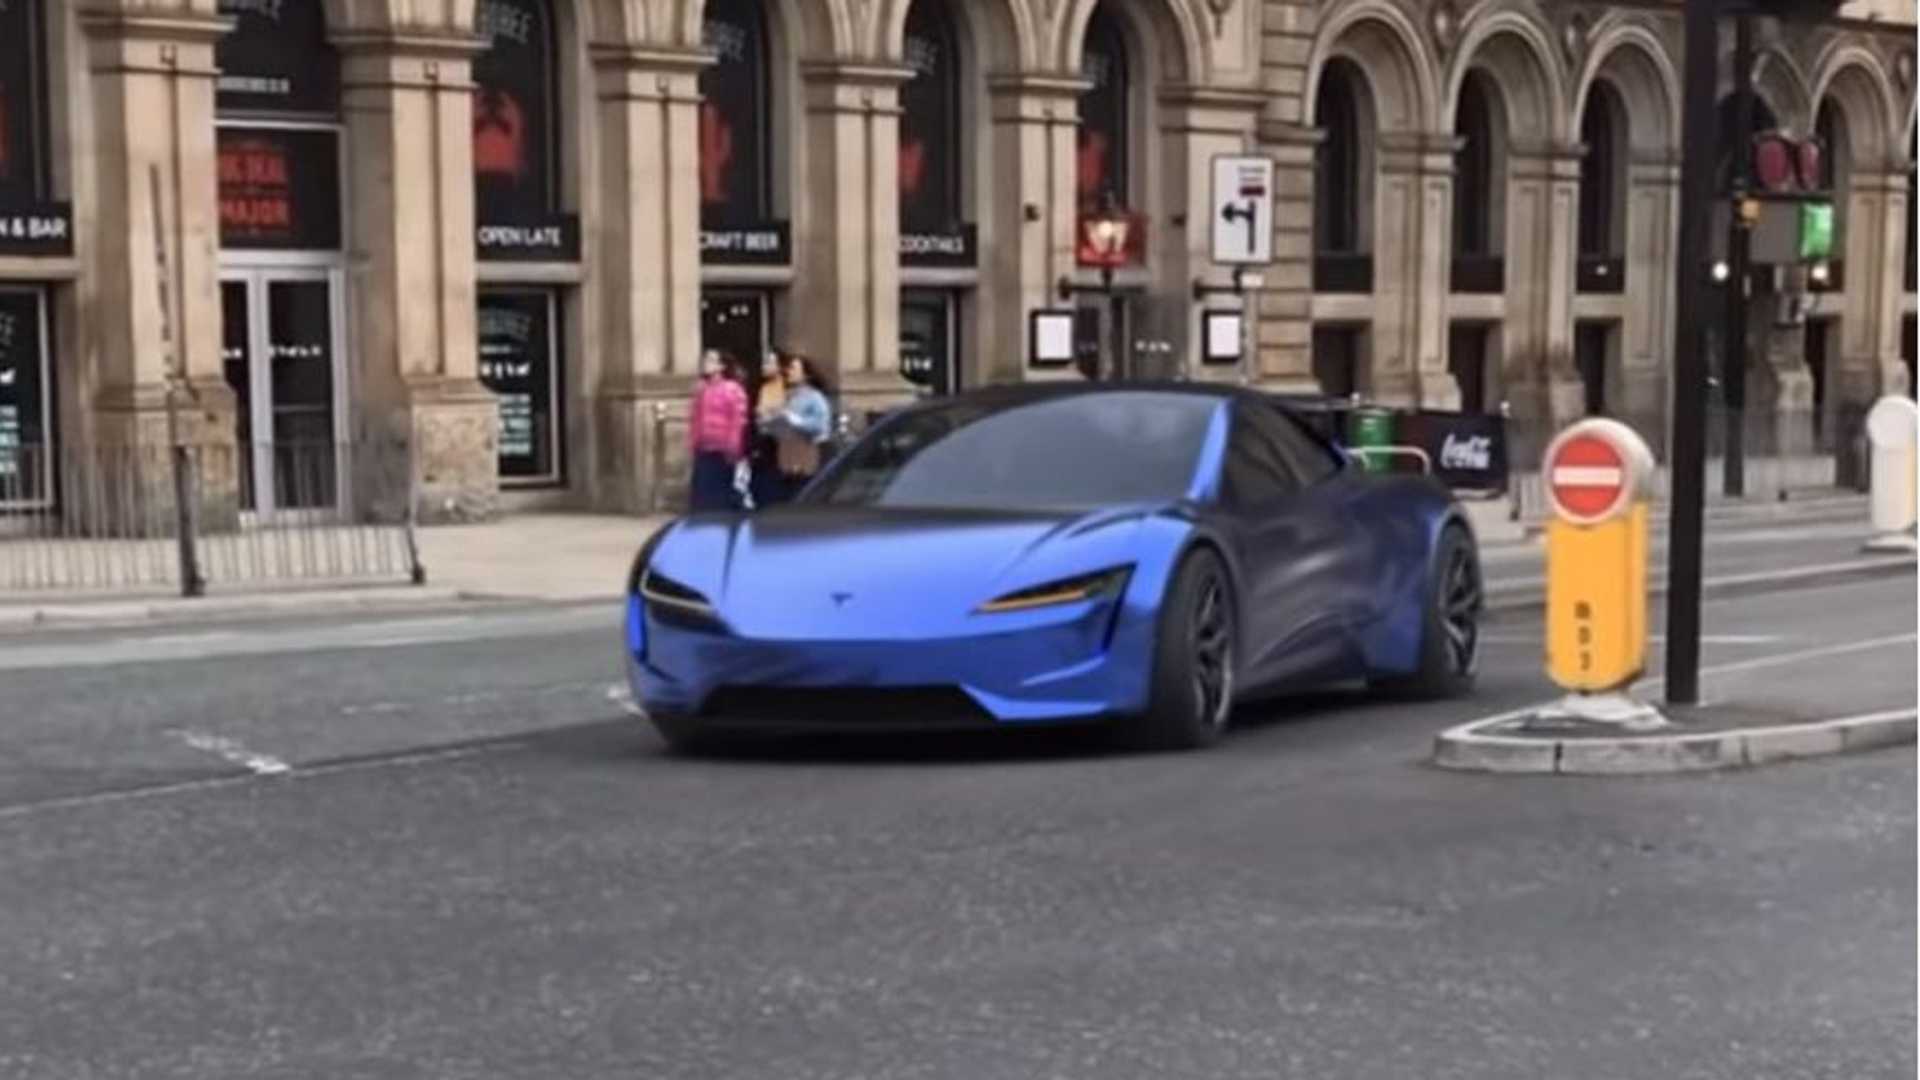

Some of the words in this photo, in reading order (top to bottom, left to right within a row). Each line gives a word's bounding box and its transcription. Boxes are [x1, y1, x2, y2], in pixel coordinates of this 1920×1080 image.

[11, 216, 25, 237] &
[28, 216, 67, 238] BAR
[479, 226, 521, 247] OPEN
[525, 226, 561, 247] LATE
[700, 230, 742, 250] CRAFT
[745, 230, 778, 251] BEER
